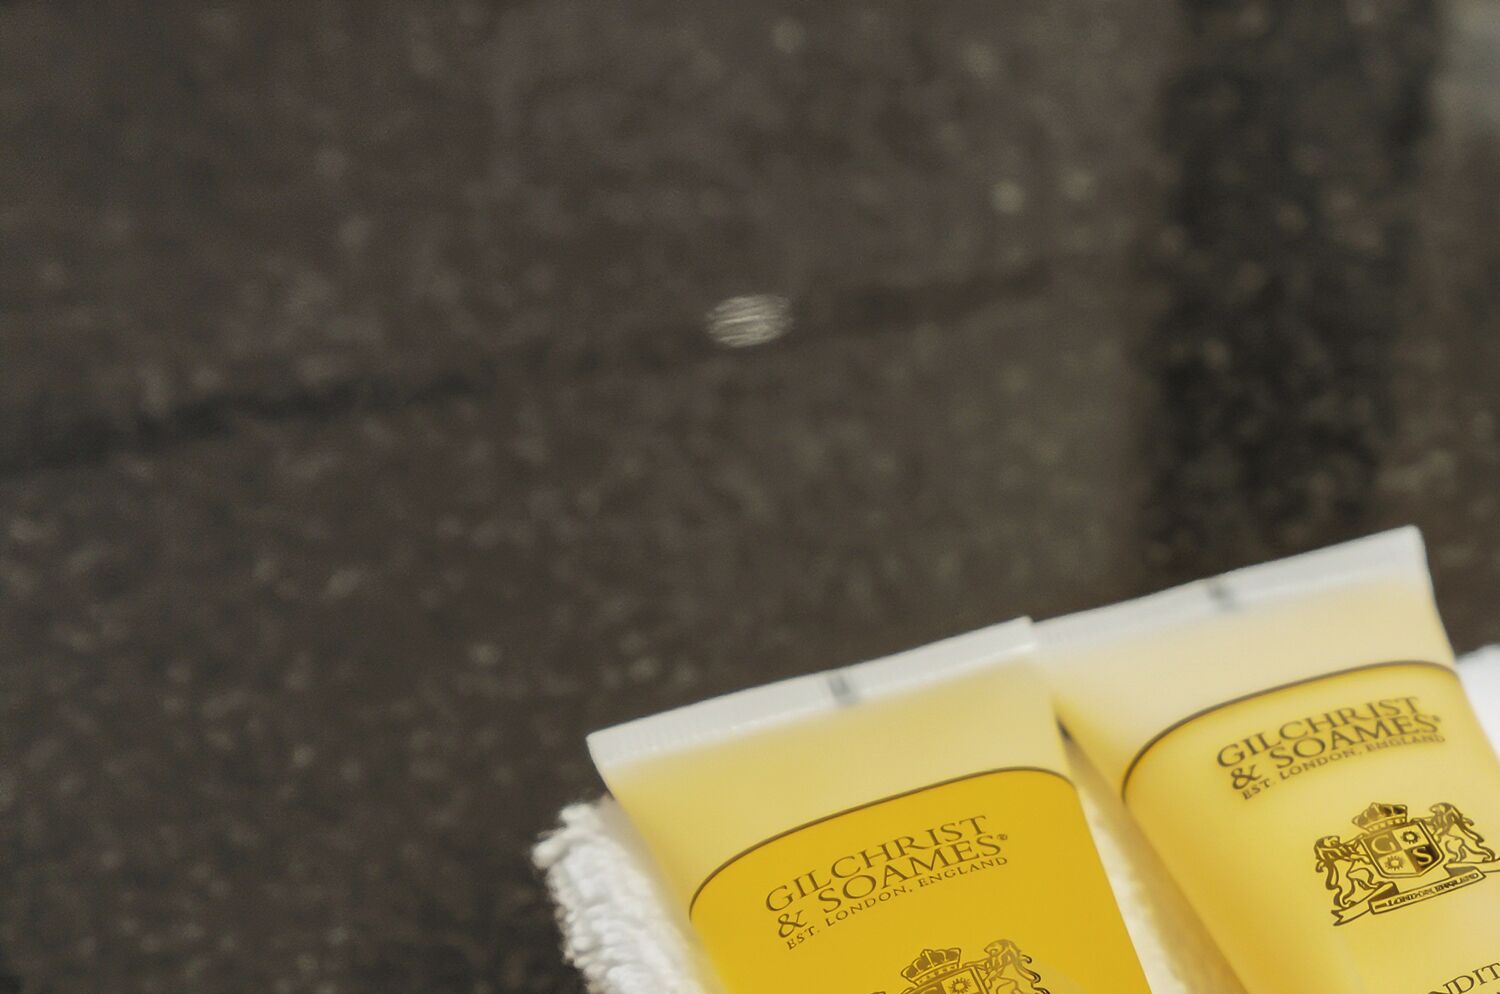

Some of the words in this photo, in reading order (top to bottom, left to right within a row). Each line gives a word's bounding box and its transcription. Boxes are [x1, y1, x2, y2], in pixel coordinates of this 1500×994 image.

[1216, 696, 1419, 769] GILCHRIST
[1231, 764, 1263, 791] &
[765, 815, 987, 914] GILCHRIST
[777, 910, 808, 939] &
[786, 925, 820, 951] EST.
[918, 855, 1009, 887] ENGLAND
